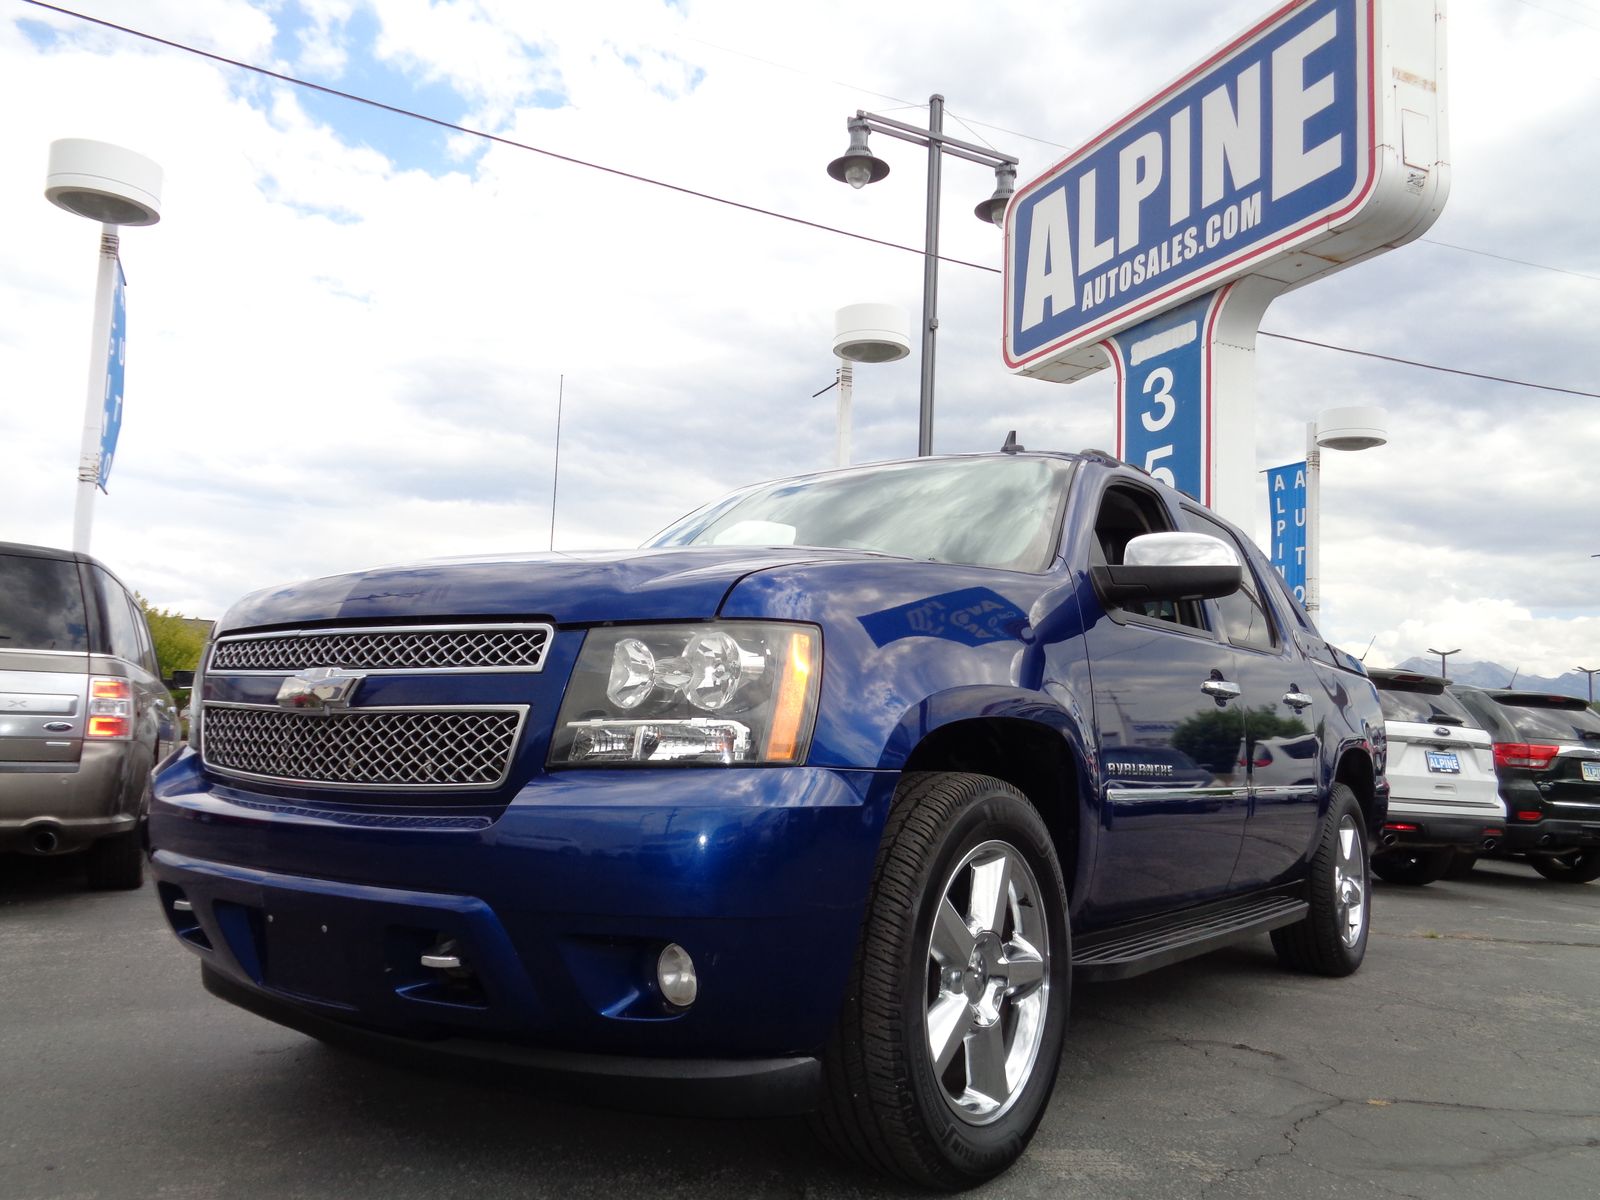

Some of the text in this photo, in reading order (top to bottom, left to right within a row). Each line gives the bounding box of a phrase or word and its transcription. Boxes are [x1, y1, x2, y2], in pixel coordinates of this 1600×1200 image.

[1021, 9, 1342, 332] ALPINE
[1081, 191, 1261, 312] AUTOSALES.COM
[1294, 470, 1306, 603] AUTO
[1107, 762, 1173, 777] AVALANCHE
[1430, 757, 1459, 770] ALPINE
